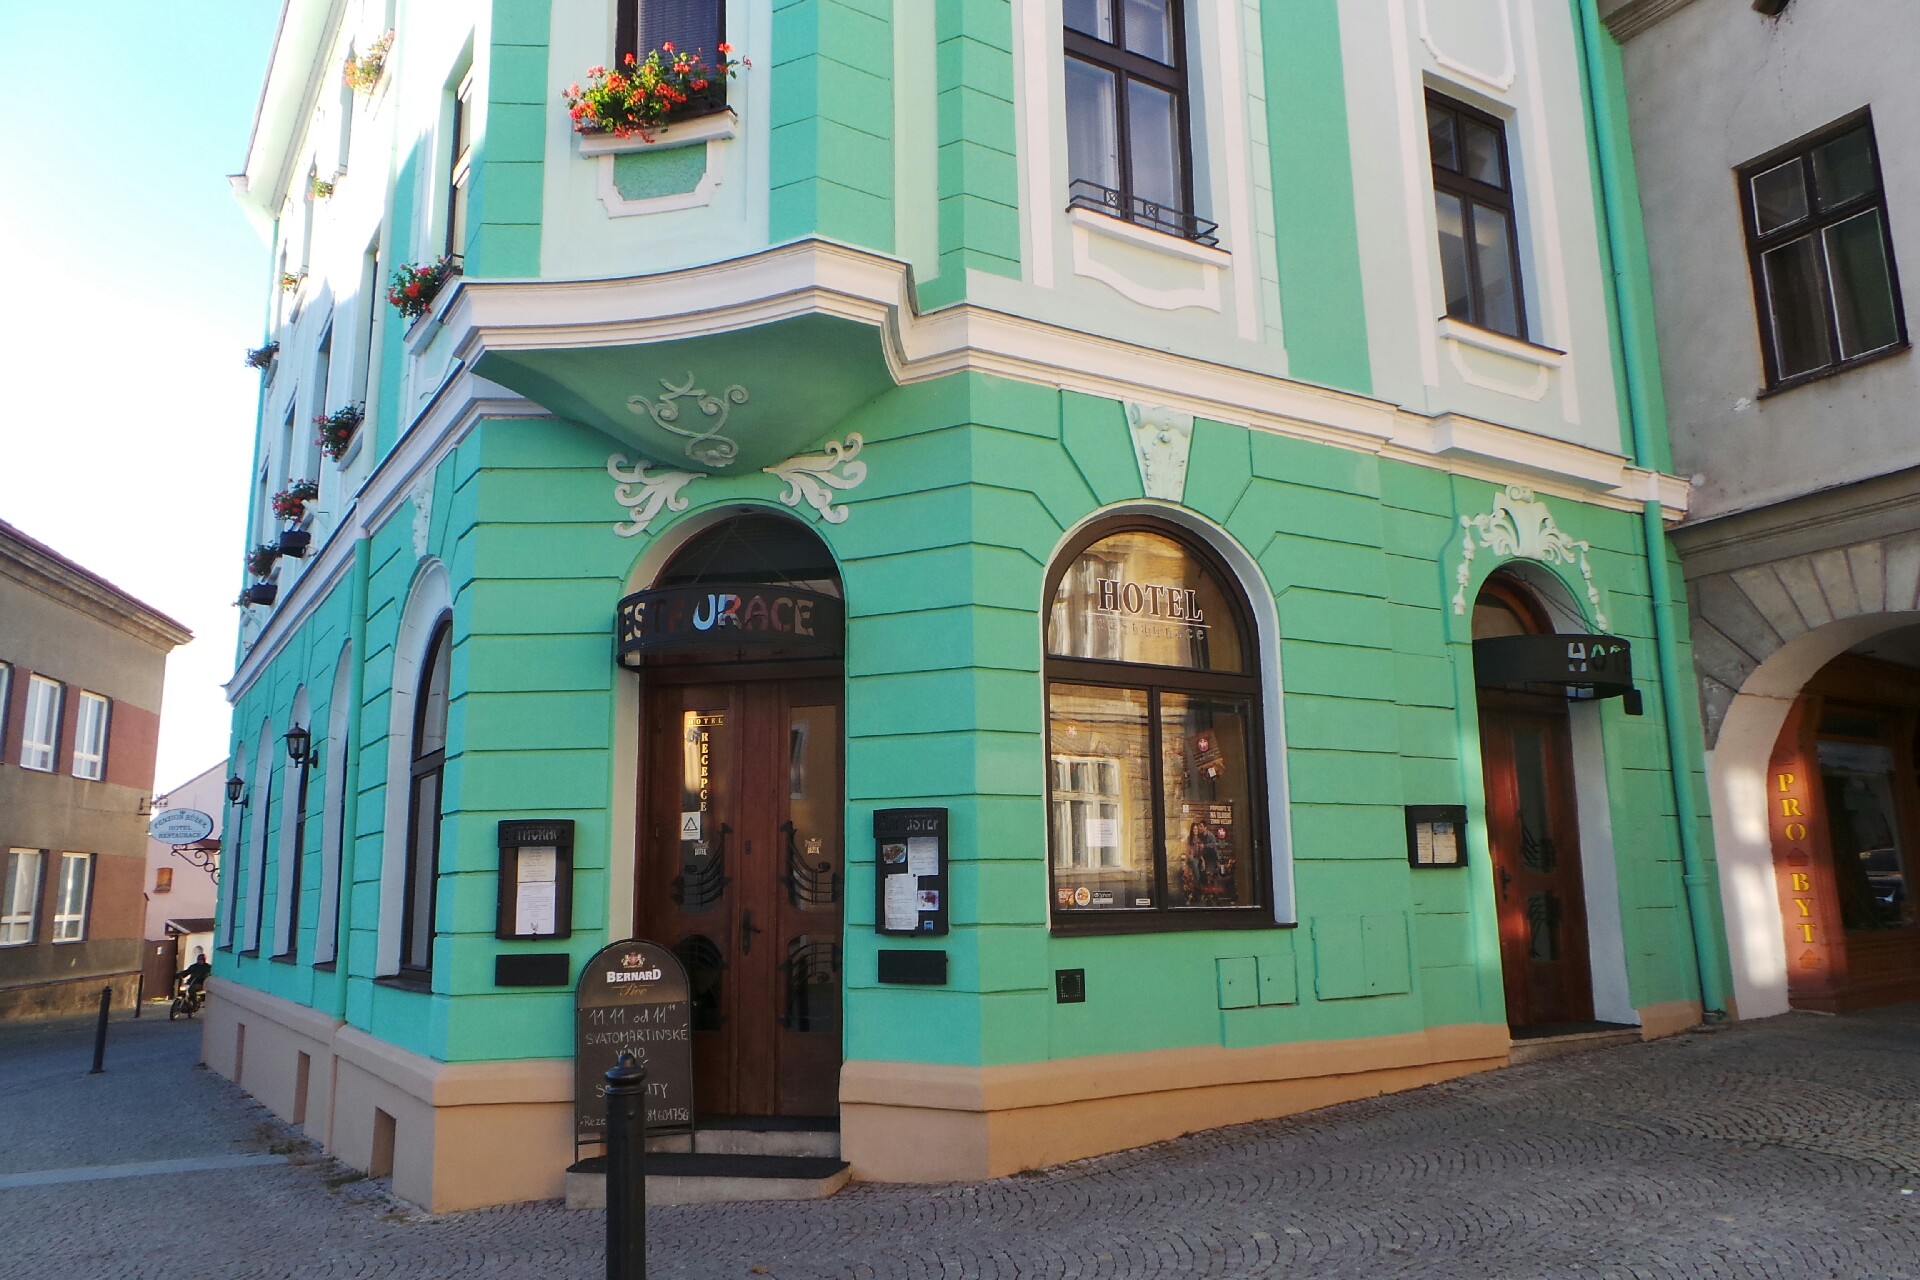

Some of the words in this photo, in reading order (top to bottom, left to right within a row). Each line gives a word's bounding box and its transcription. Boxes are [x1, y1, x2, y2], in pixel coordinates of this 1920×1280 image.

[1097, 578, 1203, 622] HOTEL
[700, 732, 709, 812] RECEPCE
[1778, 773, 1807, 841] PRO
[1791, 873, 1816, 943] BYT
[606, 968, 662, 984] BERNARD
[633, 1009, 649, 1023] od
